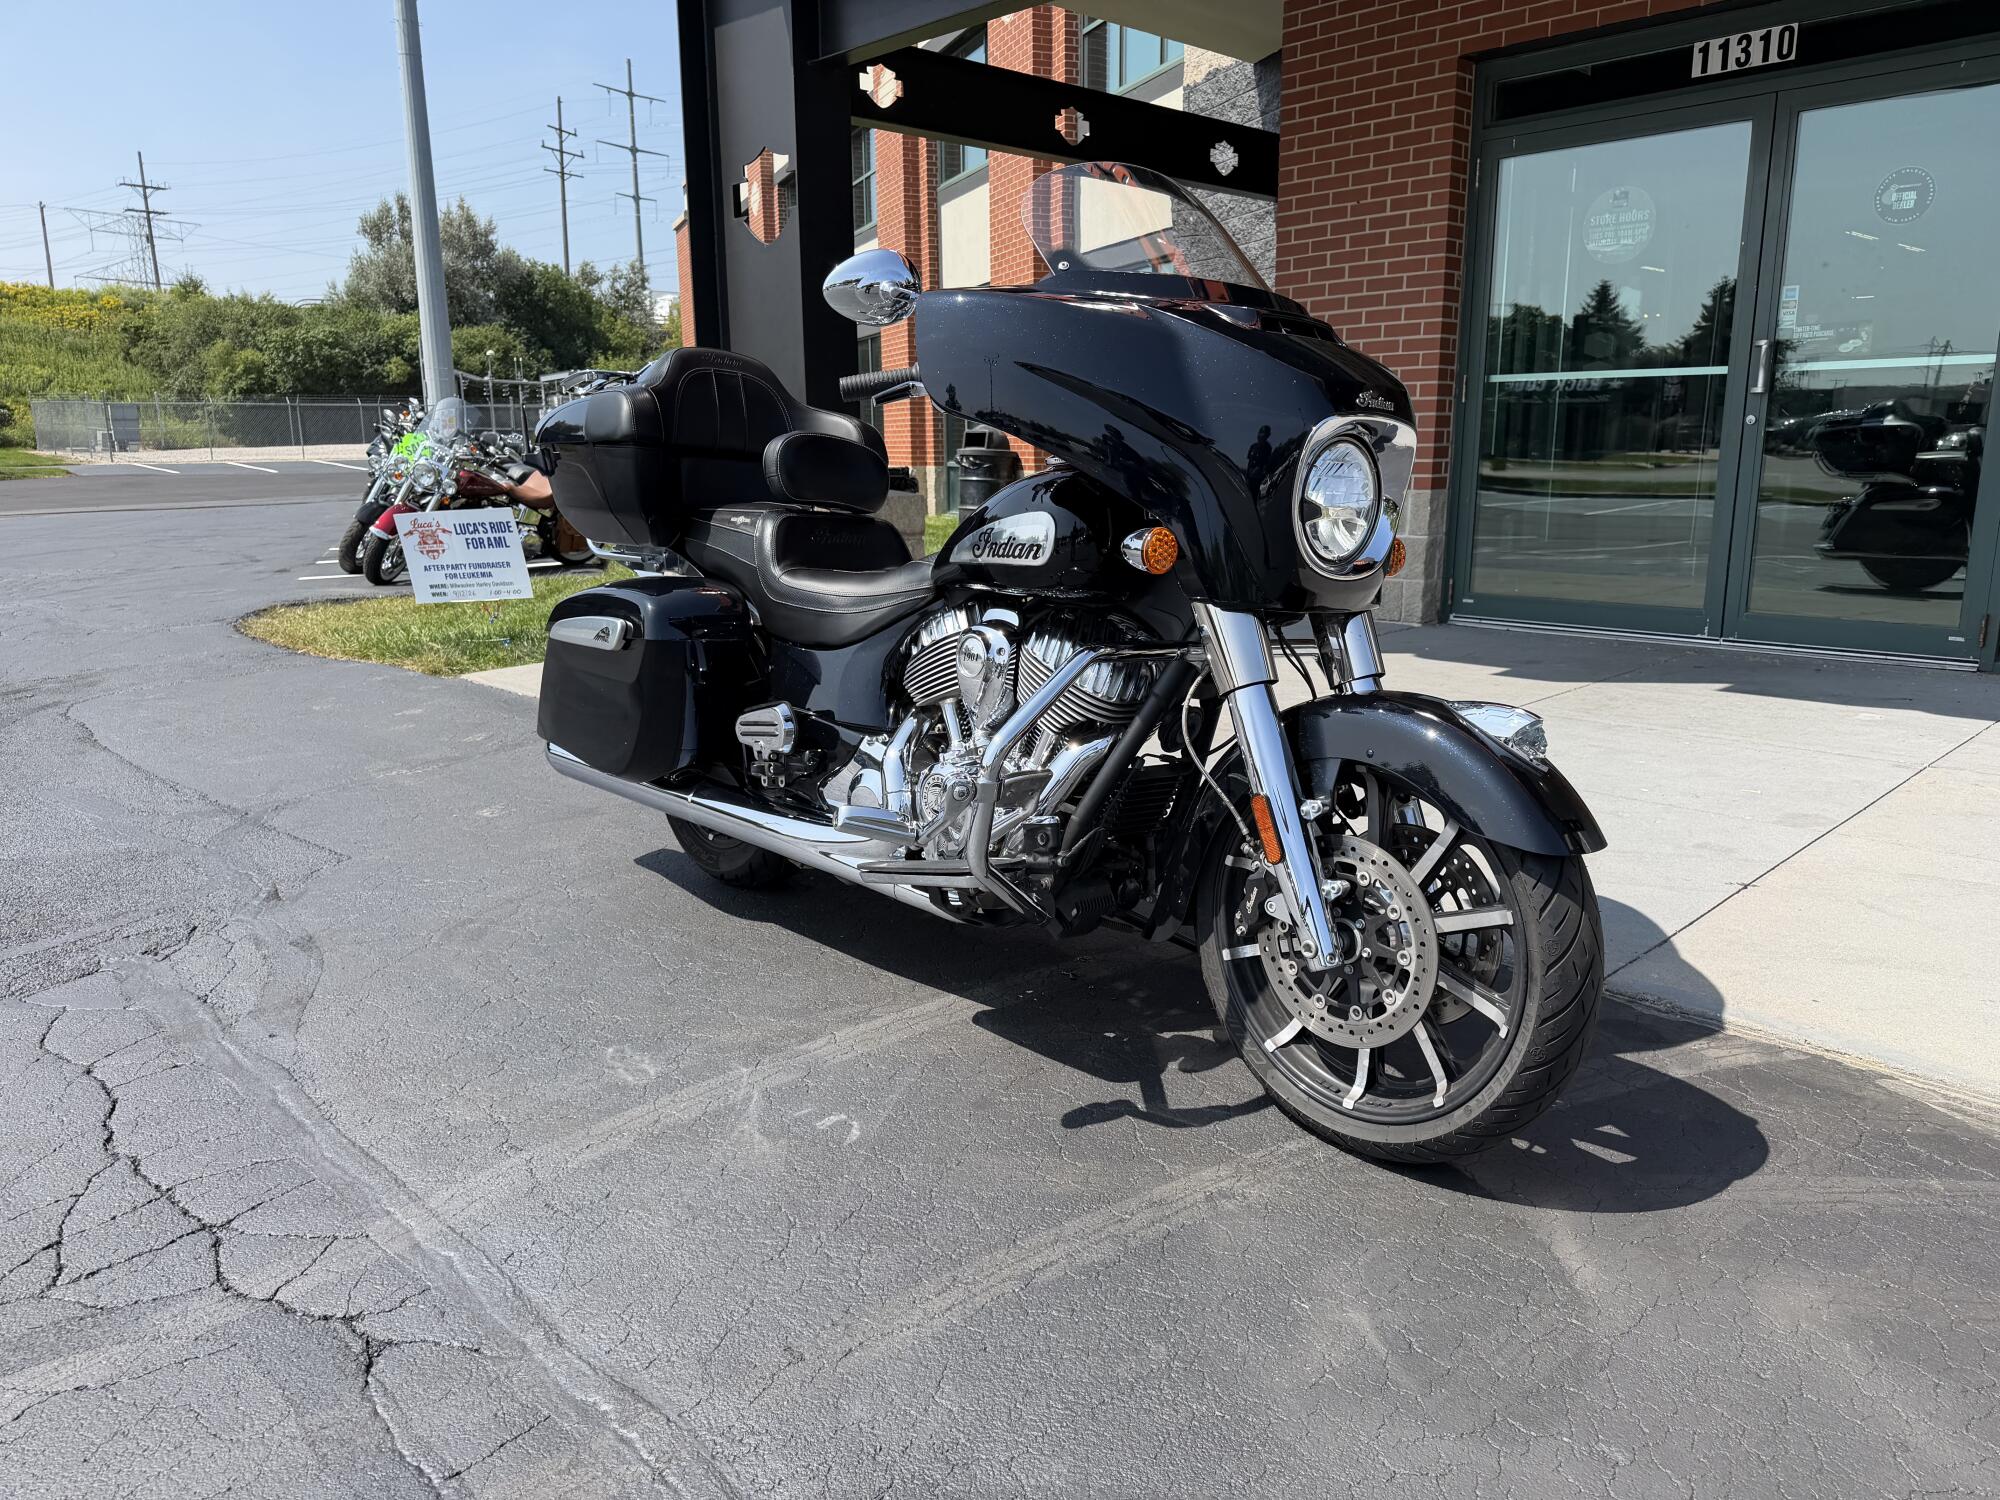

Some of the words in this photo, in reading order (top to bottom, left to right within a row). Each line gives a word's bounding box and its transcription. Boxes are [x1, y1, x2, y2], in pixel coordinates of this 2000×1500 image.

[1698, 25, 1796, 75] 11310
[1590, 213, 1617, 226] STORE
[1619, 208, 1650, 222] HOURS
[1356, 390, 1394, 411] Indian
[410, 517, 441, 529] Luca's
[453, 522, 489, 536] LUCA'S
[490, 521, 514, 534] RIDE
[465, 537, 487, 550] FOR
[487, 536, 511, 549] AML
[972, 527, 1042, 560] Indian
[424, 564, 445, 572] AFTER
[446, 563, 467, 571] PARTY
[468, 561, 511, 570] FUNDRAISER
[460, 571, 493, 579] LEUKEMIA
[963, 652, 979, 662] 1901
